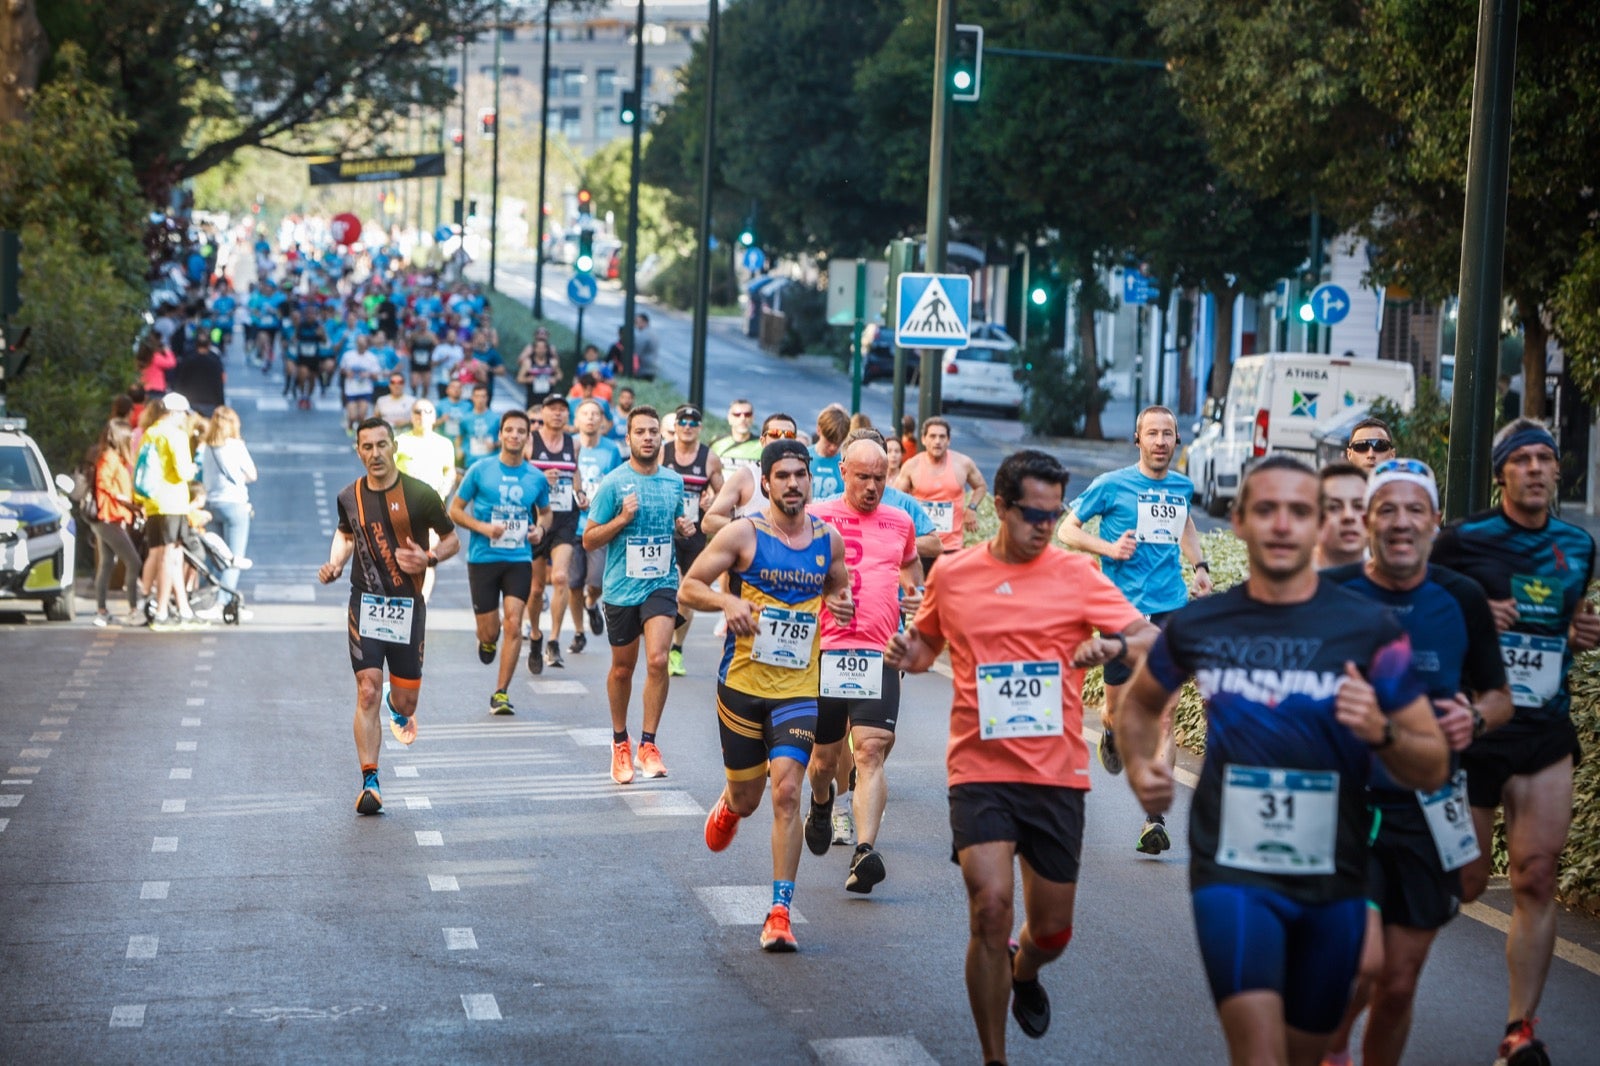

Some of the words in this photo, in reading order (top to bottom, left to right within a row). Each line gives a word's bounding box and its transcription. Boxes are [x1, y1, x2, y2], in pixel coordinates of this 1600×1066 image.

[1286, 368, 1329, 380] ATHISA
[1151, 505, 1176, 519] 639
[371, 522, 404, 587] RUNNING
[640, 546, 662, 557] 131
[369, 605, 405, 620] 2122
[770, 620, 809, 640] 1785
[836, 657, 868, 672] 490
[1505, 650, 1543, 671] 344
[999, 679, 1041, 698] 420
[1260, 794, 1295, 820] 31
